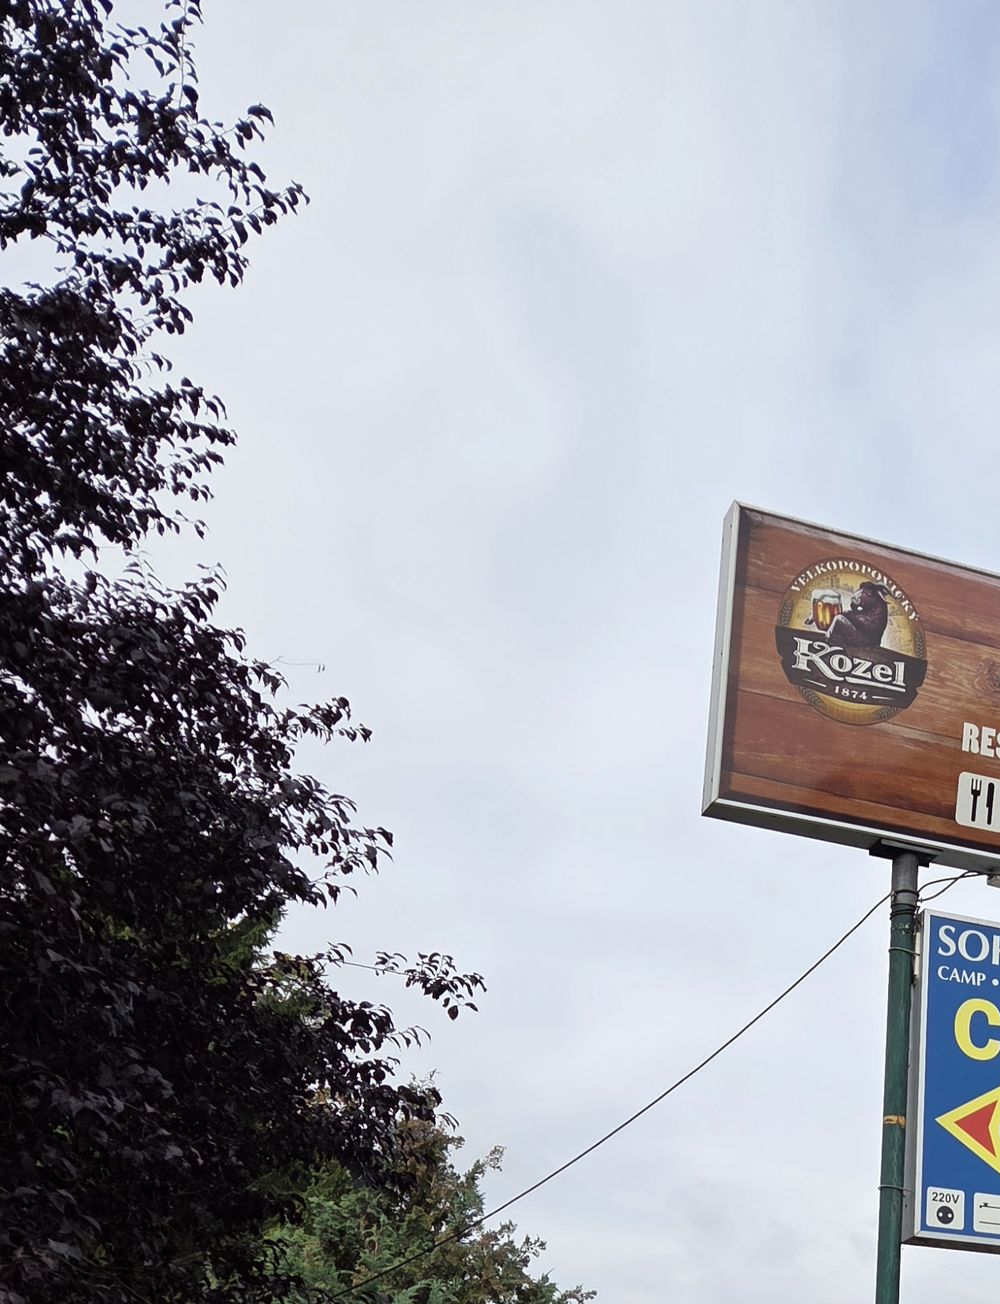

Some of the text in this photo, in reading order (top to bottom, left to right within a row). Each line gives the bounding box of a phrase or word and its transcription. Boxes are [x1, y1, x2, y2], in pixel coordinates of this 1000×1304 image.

[792, 637, 906, 687] Kozel
[834, 685, 868, 700] 1874
[937, 965, 987, 987] CAMP
[931, 1192, 960, 1204] 220V
